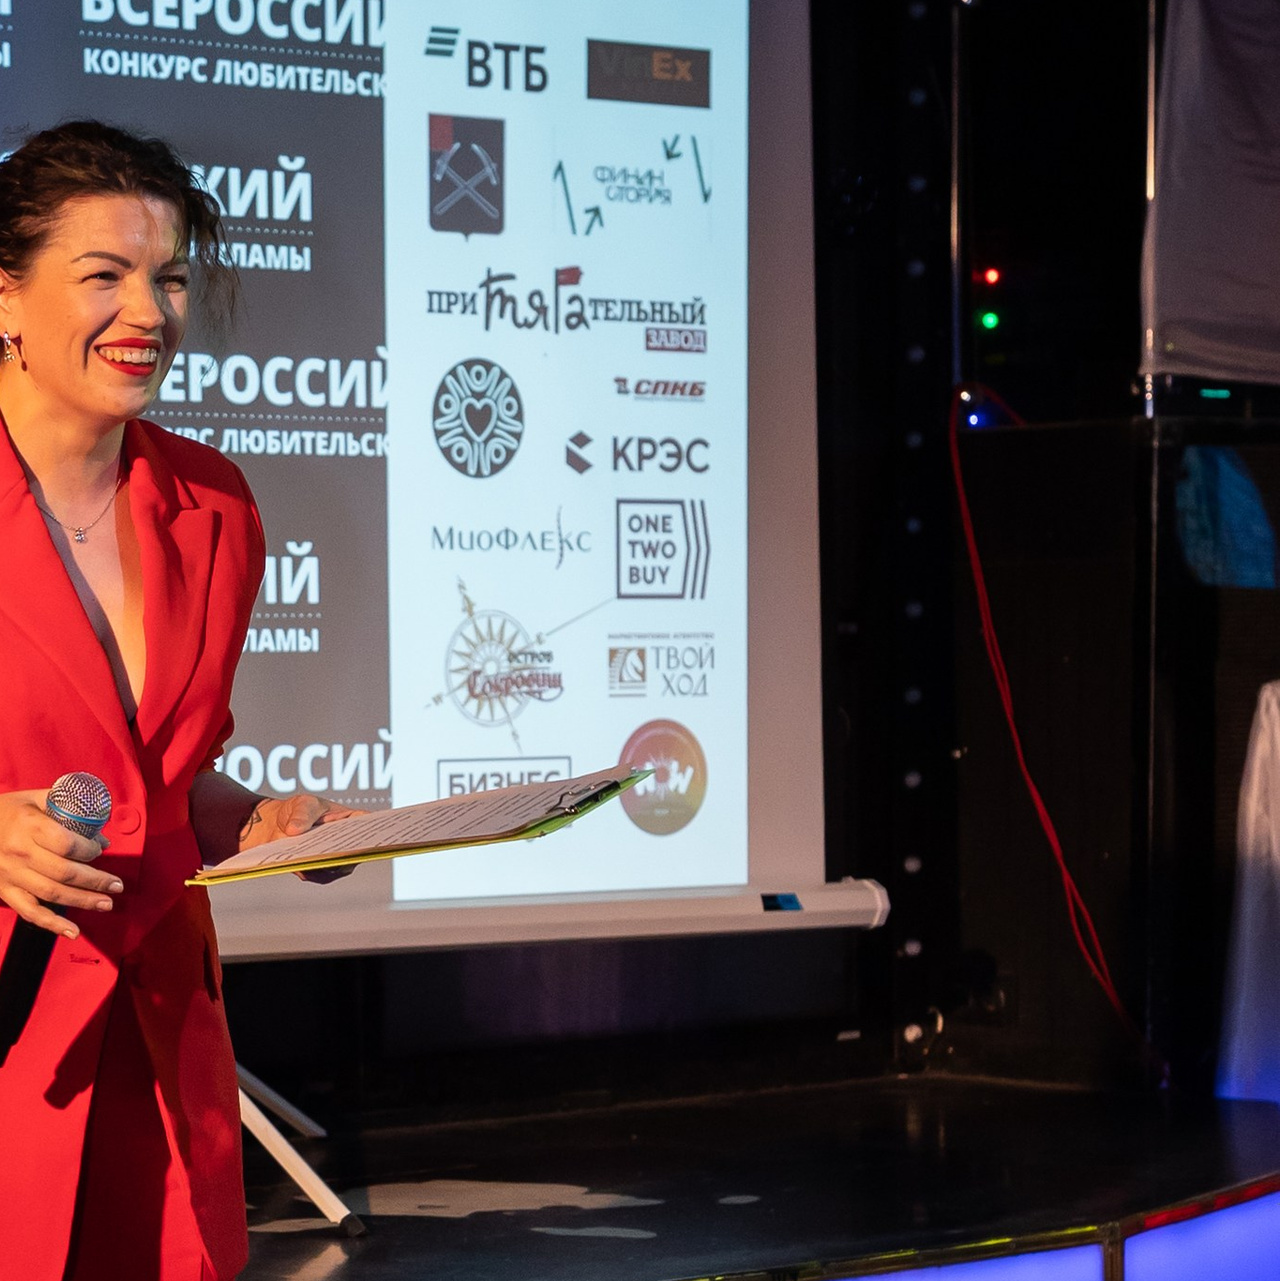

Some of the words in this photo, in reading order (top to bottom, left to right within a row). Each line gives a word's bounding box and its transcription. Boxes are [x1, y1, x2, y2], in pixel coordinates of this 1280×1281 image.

[83, 48, 208, 83] КОНКУРС
[466, 41, 549, 93] ВТБ
[647, 329, 706, 351] ЗАВОД
[612, 436, 710, 473] КРЭС
[628, 514, 672, 534] ONE
[628, 540, 676, 559] TWO
[628, 565, 670, 585] BUY
[651, 642, 715, 669] ТВОЙ
[662, 673, 708, 696] ХОД
